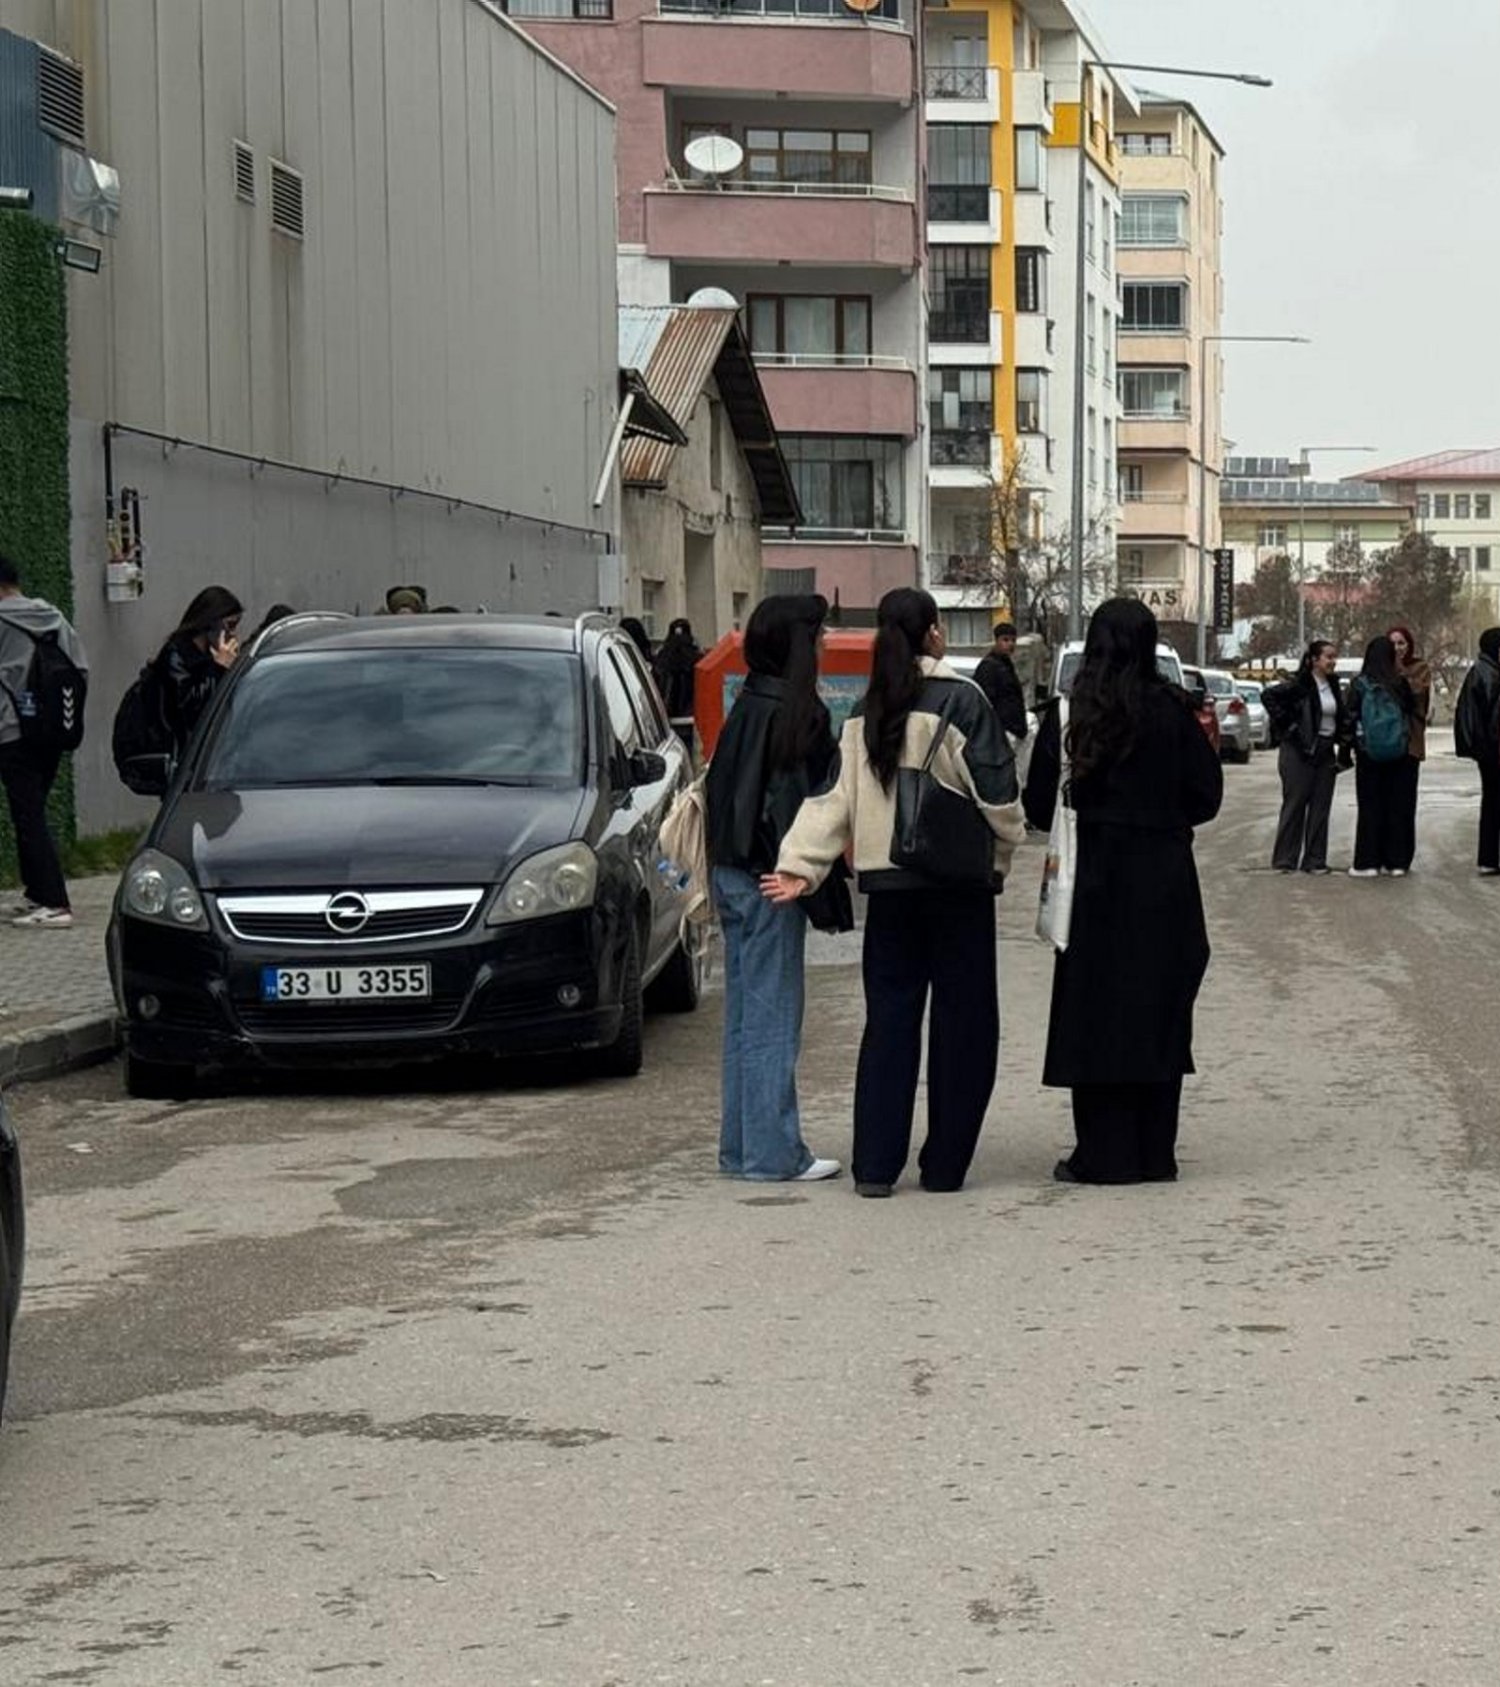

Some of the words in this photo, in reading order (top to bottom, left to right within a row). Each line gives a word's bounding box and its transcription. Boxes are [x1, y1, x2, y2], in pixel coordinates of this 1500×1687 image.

[279, 971, 310, 996] 33
[326, 970, 342, 995] U
[357, 968, 425, 994] 3355
